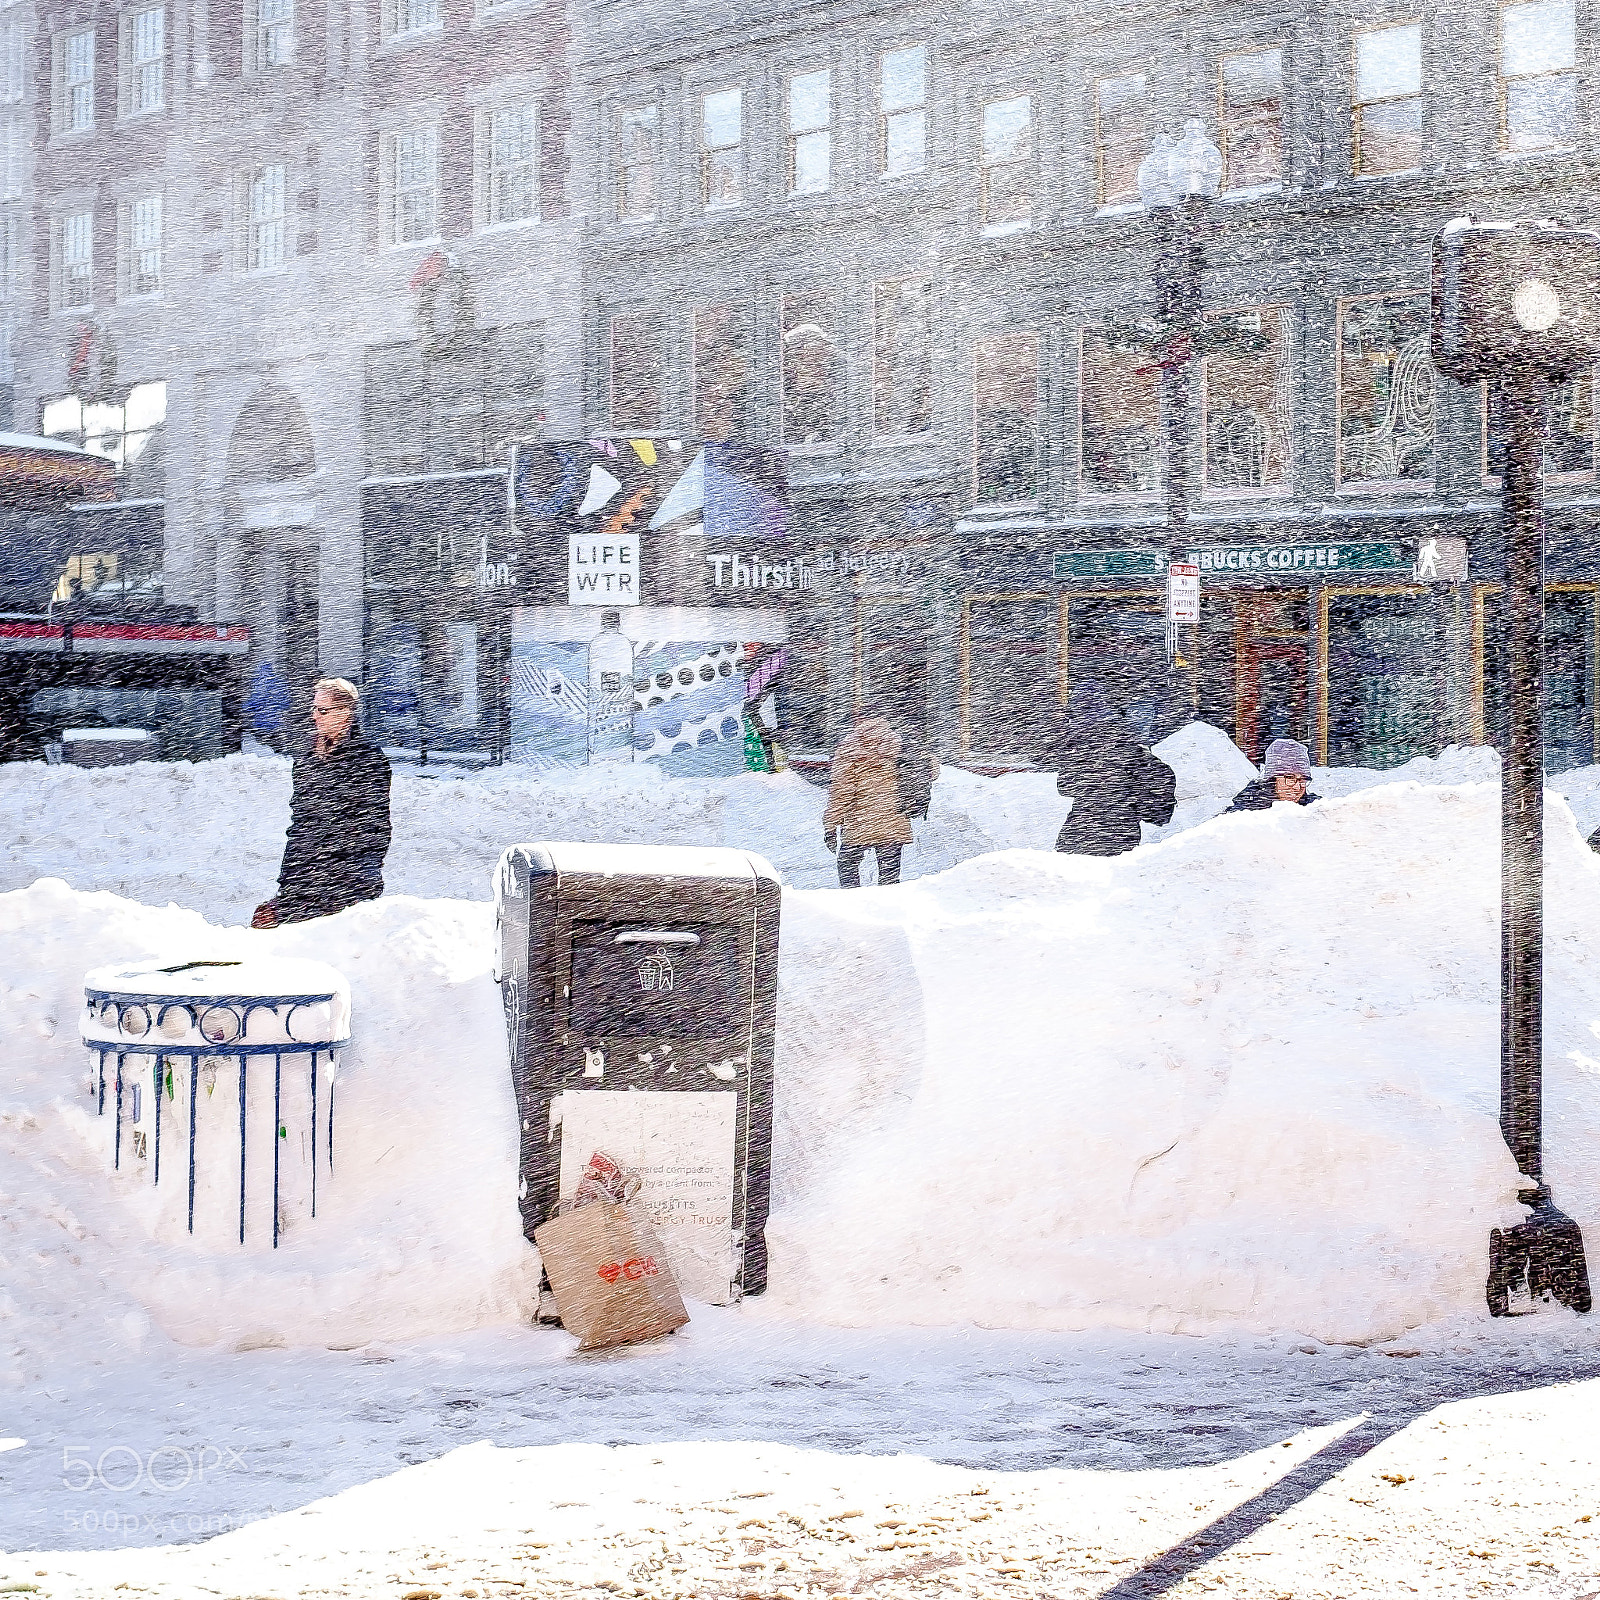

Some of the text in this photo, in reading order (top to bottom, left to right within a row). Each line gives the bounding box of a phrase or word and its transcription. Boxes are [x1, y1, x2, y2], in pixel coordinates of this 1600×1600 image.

[577, 545, 632, 564] LIFE
[1154, 549, 1339, 570] SRBUCKS COFFEE
[706, 553, 794, 588] Thirst
[577, 573, 632, 593] WTR
[666, 1164, 714, 1176] compactor
